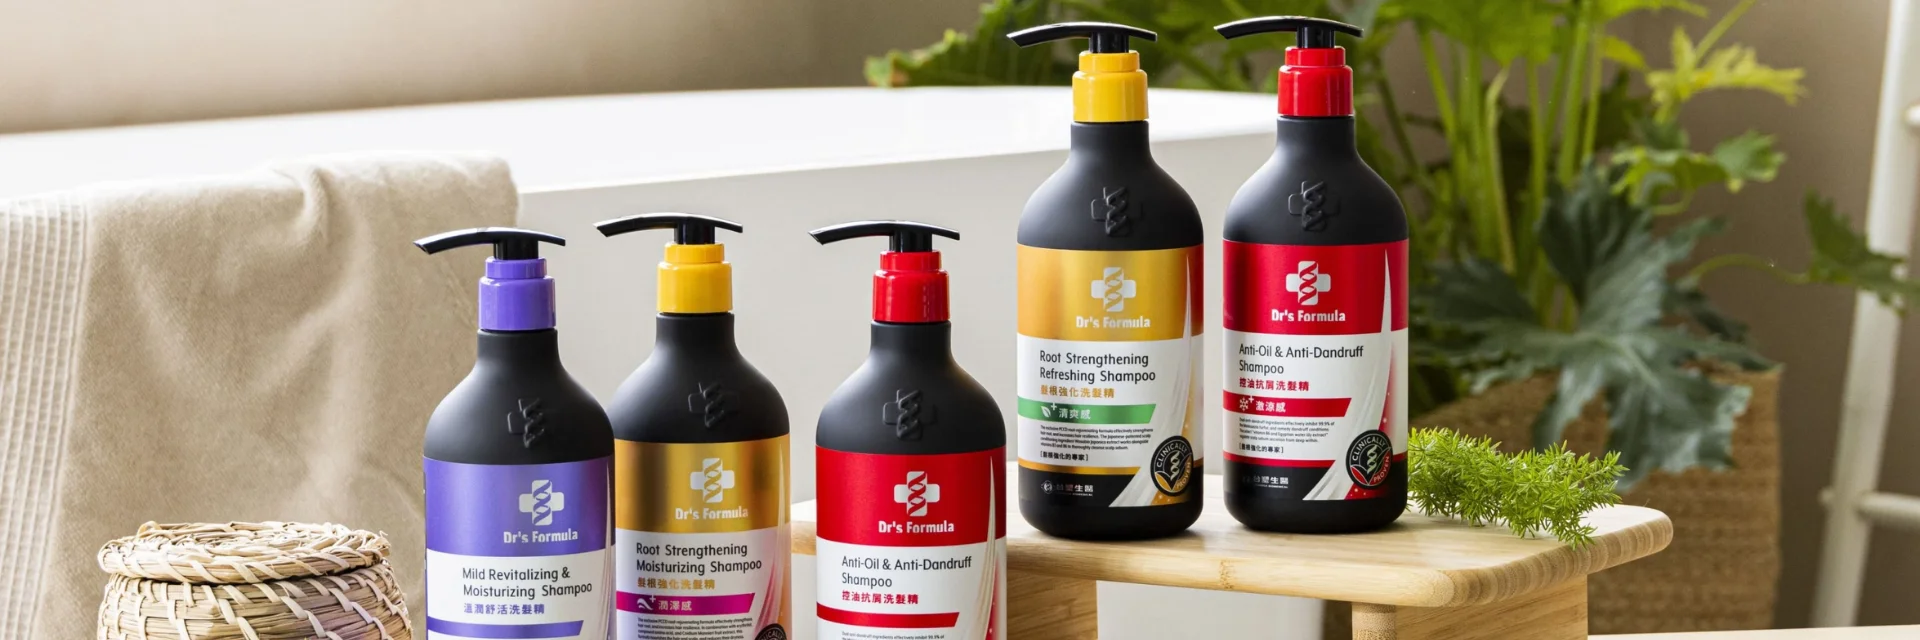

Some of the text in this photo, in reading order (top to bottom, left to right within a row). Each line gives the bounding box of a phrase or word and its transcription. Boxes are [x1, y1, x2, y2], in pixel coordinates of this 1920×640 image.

[1076, 316, 1150, 328] Dr's Formula
[1272, 309, 1346, 322] Dr's Formula
[1040, 350, 1148, 368] Root Strengthening
[1239, 344, 1363, 358] Anti-Oil & Anti-Dandruff
[1040, 367, 1156, 384] Refreshing Shampoo
[1239, 360, 1284, 376] Shampoo
[1240, 377, 1310, 391] 控油抗屑洗髮精
[1059, 408, 1091, 420] 清爽感
[1156, 442, 1187, 468] CLINICALLY
[1352, 436, 1386, 461] CLINICALLY
[1374, 456, 1390, 482] PROVEN
[676, 506, 749, 520] Dr's Formula
[878, 520, 954, 533] Dr's Formula
[503, 528, 578, 543] Dr's Formula
[636, 542, 748, 559] Root Strengthening
[636, 560, 762, 576] Moisturizing Shampoo
[842, 556, 972, 570] Anti-Oil & Anti-Dandruff
[462, 566, 570, 582] Mild Revitalizing &
[842, 572, 892, 589] Shampoo
[463, 583, 592, 600] Moisturizing Shampoo
[842, 590, 918, 604] 控油抗屑洗髮精
